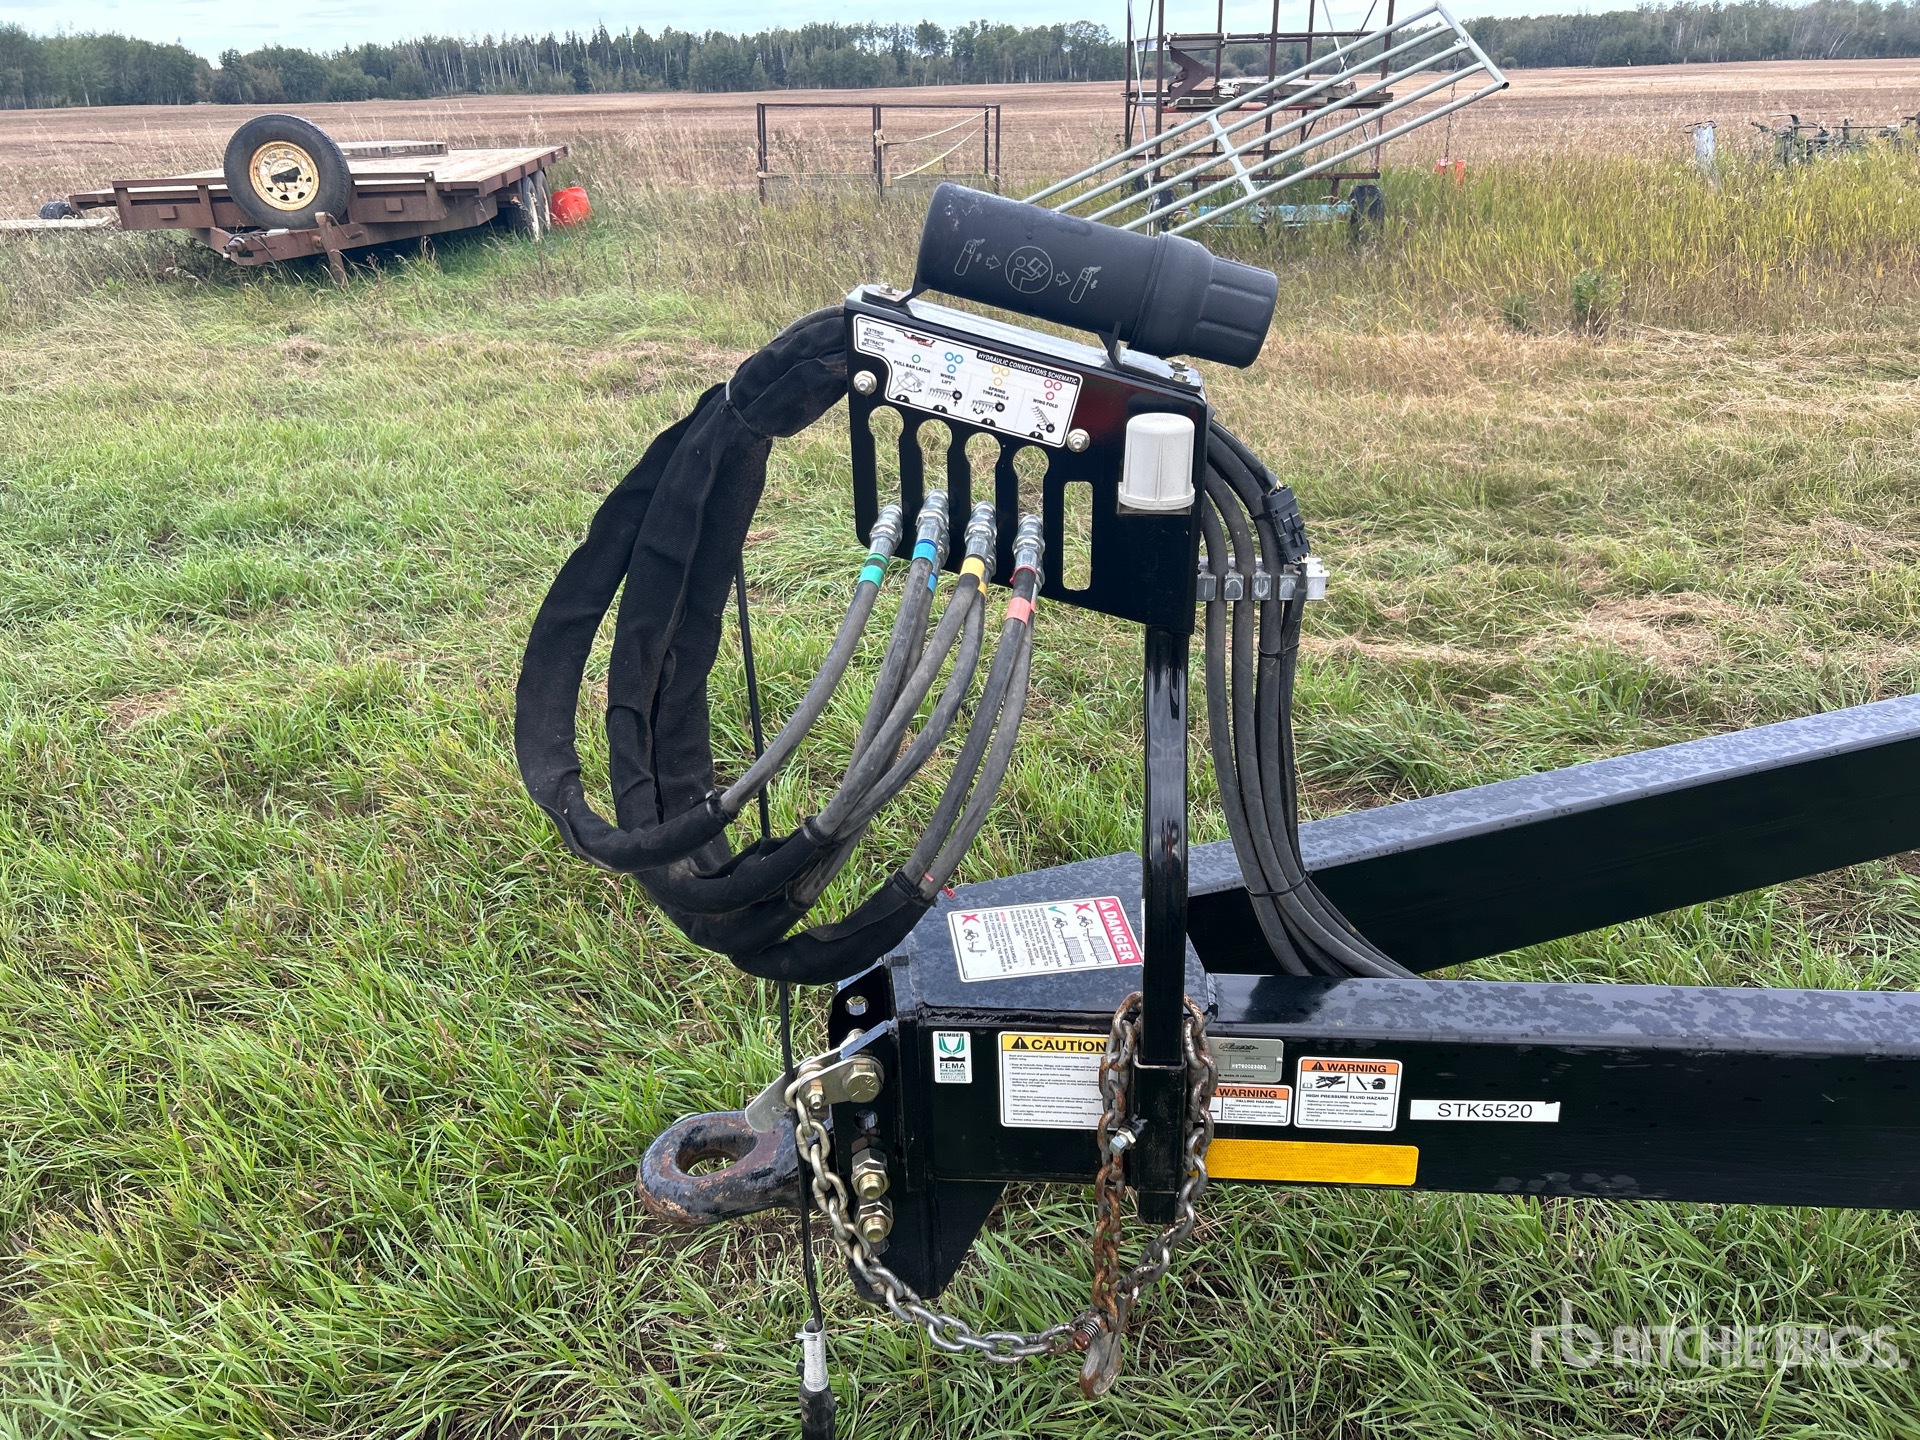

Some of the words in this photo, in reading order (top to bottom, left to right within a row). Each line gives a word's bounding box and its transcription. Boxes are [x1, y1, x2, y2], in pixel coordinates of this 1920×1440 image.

[978, 352, 1009, 366] HYDRAULIC
[1009, 360, 1047, 377] CONNECTIONS
[1048, 371, 1078, 384] SCHEMATIC
[988, 386, 1006, 394] SPRING
[1104, 911, 1135, 961] DANGER
[1032, 1040, 1106, 1052] CAUTION
[1327, 1063, 1387, 1072] WARNING
[1219, 1089, 1277, 1098] WARNING
[1437, 1103, 1533, 1118] STK5520
